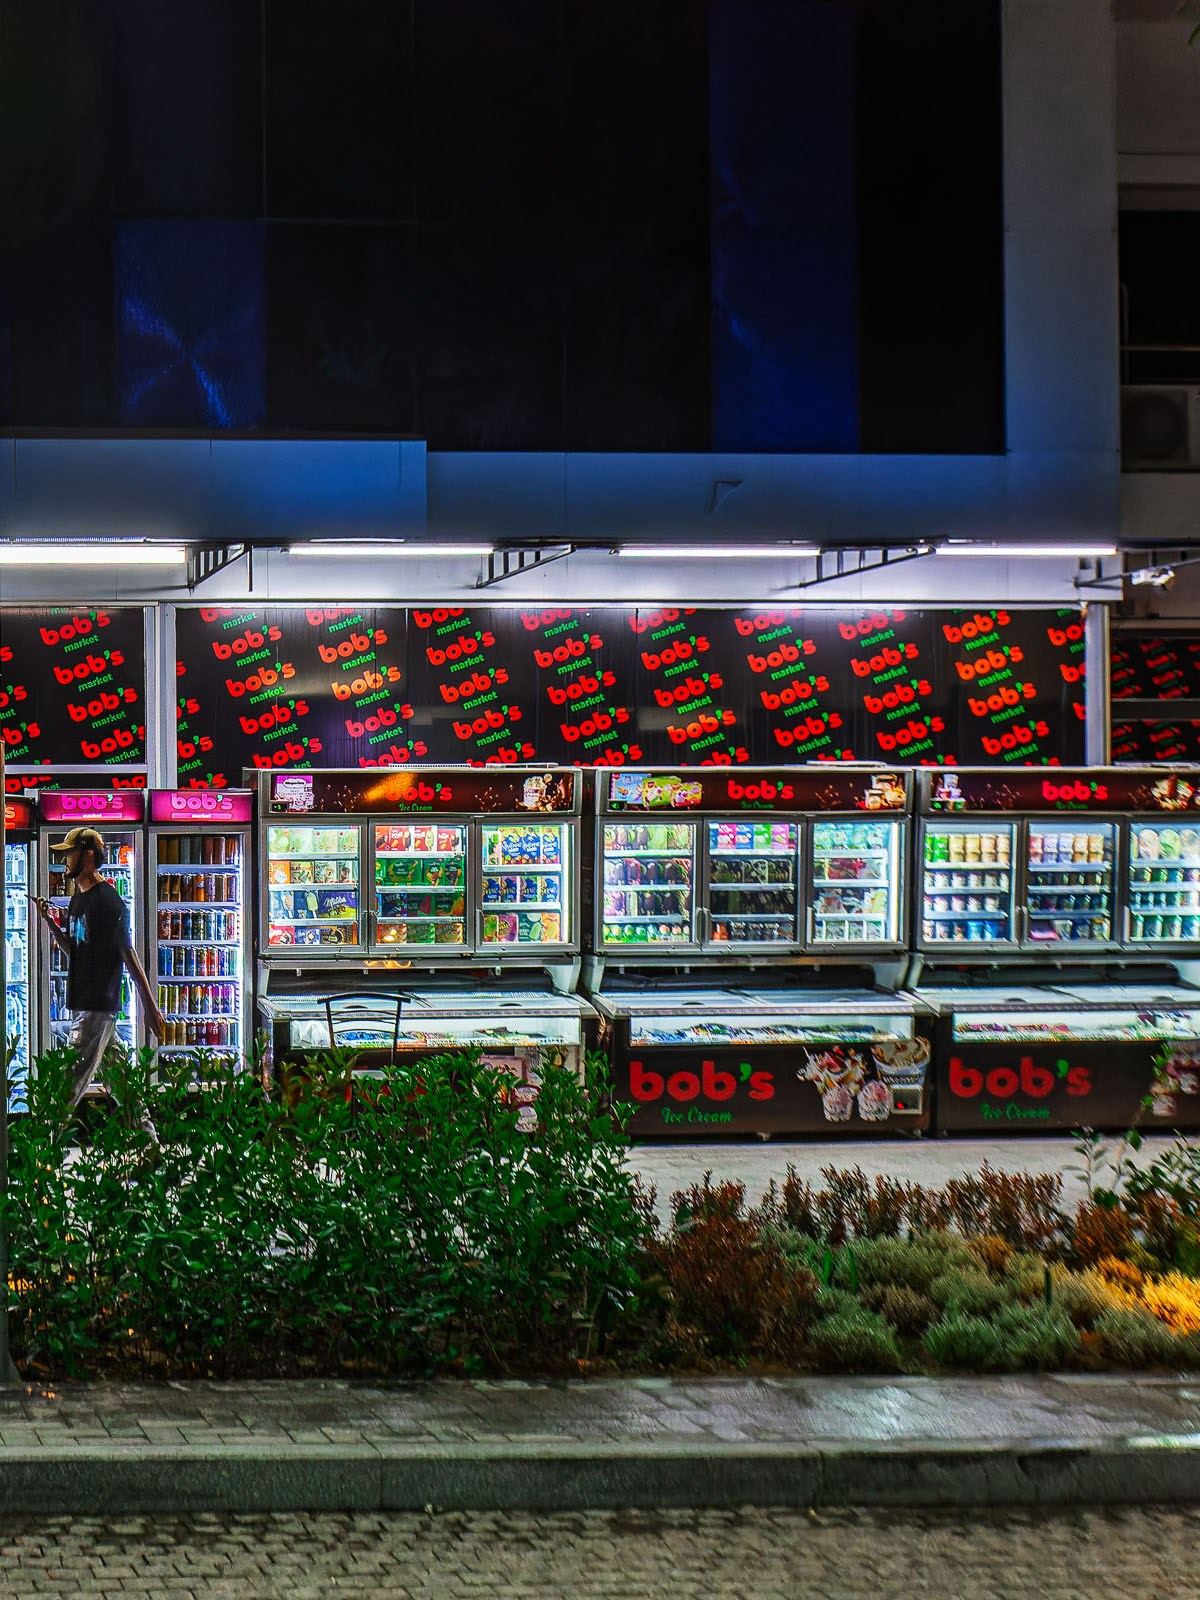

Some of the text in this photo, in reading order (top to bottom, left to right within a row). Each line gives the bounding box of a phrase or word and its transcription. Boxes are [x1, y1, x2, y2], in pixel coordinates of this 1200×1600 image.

[40, 611, 110, 645] bob's
[222, 612, 257, 630] market
[328, 616, 363, 633] market
[437, 617, 470, 635] market
[544, 620, 579, 638] market
[651, 623, 686, 640] market
[942, 608, 1011, 643] bob's
[64, 635, 99, 652] market
[212, 624, 282, 660] bob's
[757, 626, 792, 643] market
[318, 628, 387, 663] bob's
[426, 631, 495, 666] bob's
[534, 633, 603, 668] bob's
[641, 636, 710, 670] bob's
[747, 639, 816, 672] bob's
[54, 650, 124, 684] bob's
[236, 648, 271, 667] market
[342, 652, 376, 671] market
[450, 654, 484, 672] market
[557, 657, 592, 675] market
[664, 659, 699, 677] market
[850, 643, 919, 677] bob's
[955, 646, 1024, 680] bob's
[226, 662, 295, 697] bob's
[771, 662, 806, 680] market
[78, 674, 113, 691] market
[331, 666, 401, 700] bob's
[440, 668, 509, 702] bob's
[547, 671, 616, 704] bob's
[654, 673, 723, 707] bob's
[760, 676, 829, 710] bob's
[68, 688, 137, 722] bob's
[250, 686, 285, 704] market
[355, 689, 390, 707] market
[463, 691, 498, 710] market
[571, 694, 605, 712] market
[677, 696, 712, 714] market
[864, 679, 932, 713] bob's
[968, 682, 1036, 716] bob's
[239, 700, 309, 734] bob's
[784, 699, 818, 717] market
[92, 711, 126, 727] market
[346, 703, 414, 737] bob's
[453, 705, 522, 740] bob's
[560, 707, 629, 742] bob's
[666, 709, 736, 744] bob's
[774, 712, 842, 746] bob's
[263, 723, 298, 740] market
[369, 726, 403, 744] market
[477, 729, 511, 747] market
[584, 731, 618, 748] market
[690, 733, 725, 751] market
[876, 716, 944, 750] bob's
[981, 721, 1049, 755] bob's
[797, 736, 831, 753] market
[727, 779, 794, 800] bob's
[1042, 780, 1108, 801] bob's
[61, 793, 123, 810] bob's
[171, 793, 233, 810] bob's
[629, 1060, 775, 1101] bob's
[949, 1057, 1092, 1098] bob's
